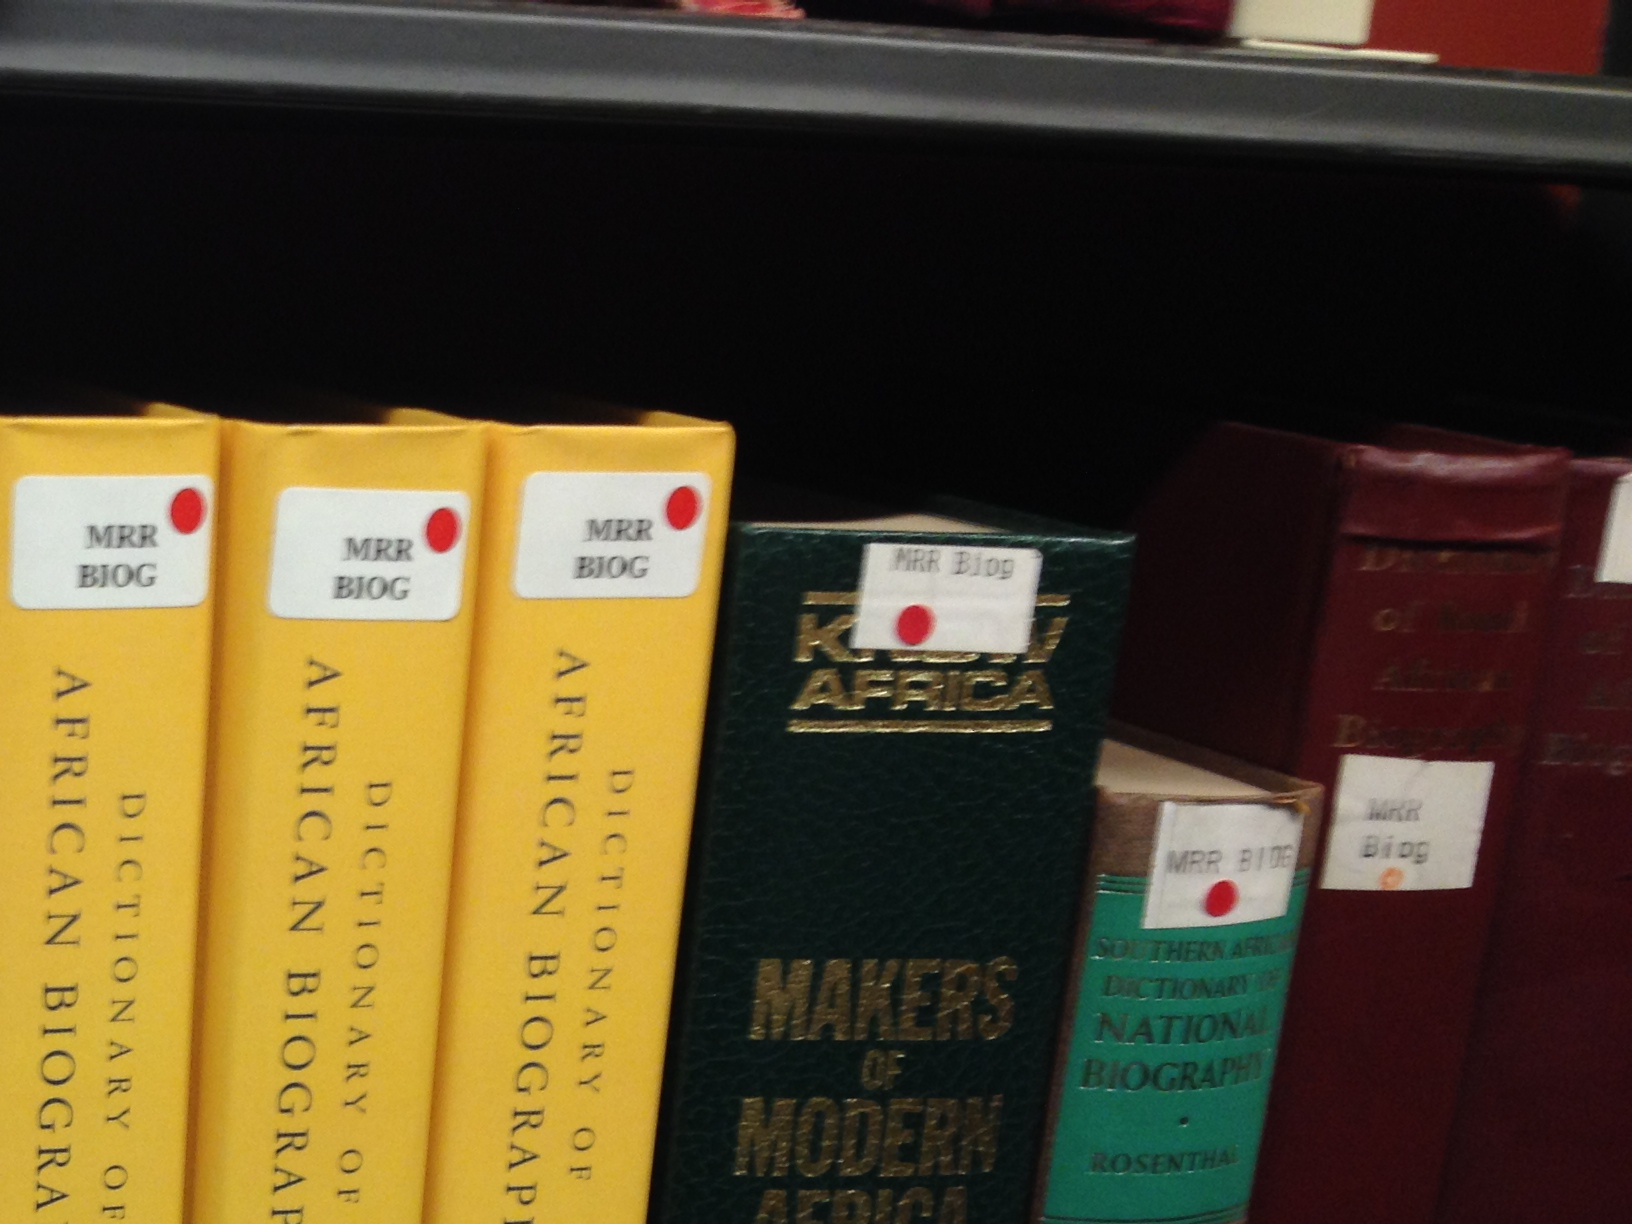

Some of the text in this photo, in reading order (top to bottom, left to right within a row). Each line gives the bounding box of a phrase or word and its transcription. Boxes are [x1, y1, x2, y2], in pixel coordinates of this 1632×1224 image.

[85, 524, 157, 549] MRR
[584, 518, 653, 542] MRR
[342, 537, 414, 563] MRR
[573, 556, 650, 579] BIOG
[893, 549, 1015, 580] MRR Biog
[76, 562, 156, 589] BIOG
[333, 576, 410, 600] BIOG
[789, 668, 1054, 710] AFRICA
[289, 658, 343, 935] AFRICAN
[531, 648, 591, 918] AFRICAN
[44, 667, 92, 948] AFRICAN
[1168, 850, 1223, 874] MRR
[337, 780, 393, 1204] DICTIONARY OF
[570, 769, 635, 1182] DICTIONARY OF
[1103, 973, 1248, 1001] DICTIONARY
[102, 791, 147, 1220] DICTIONARY OF
[748, 955, 1018, 1041] MAKERS
[862, 1050, 905, 1090] OF
[732, 1094, 1003, 1177] MODERN
[1088, 1144, 1239, 1174] ROSENTHAL
